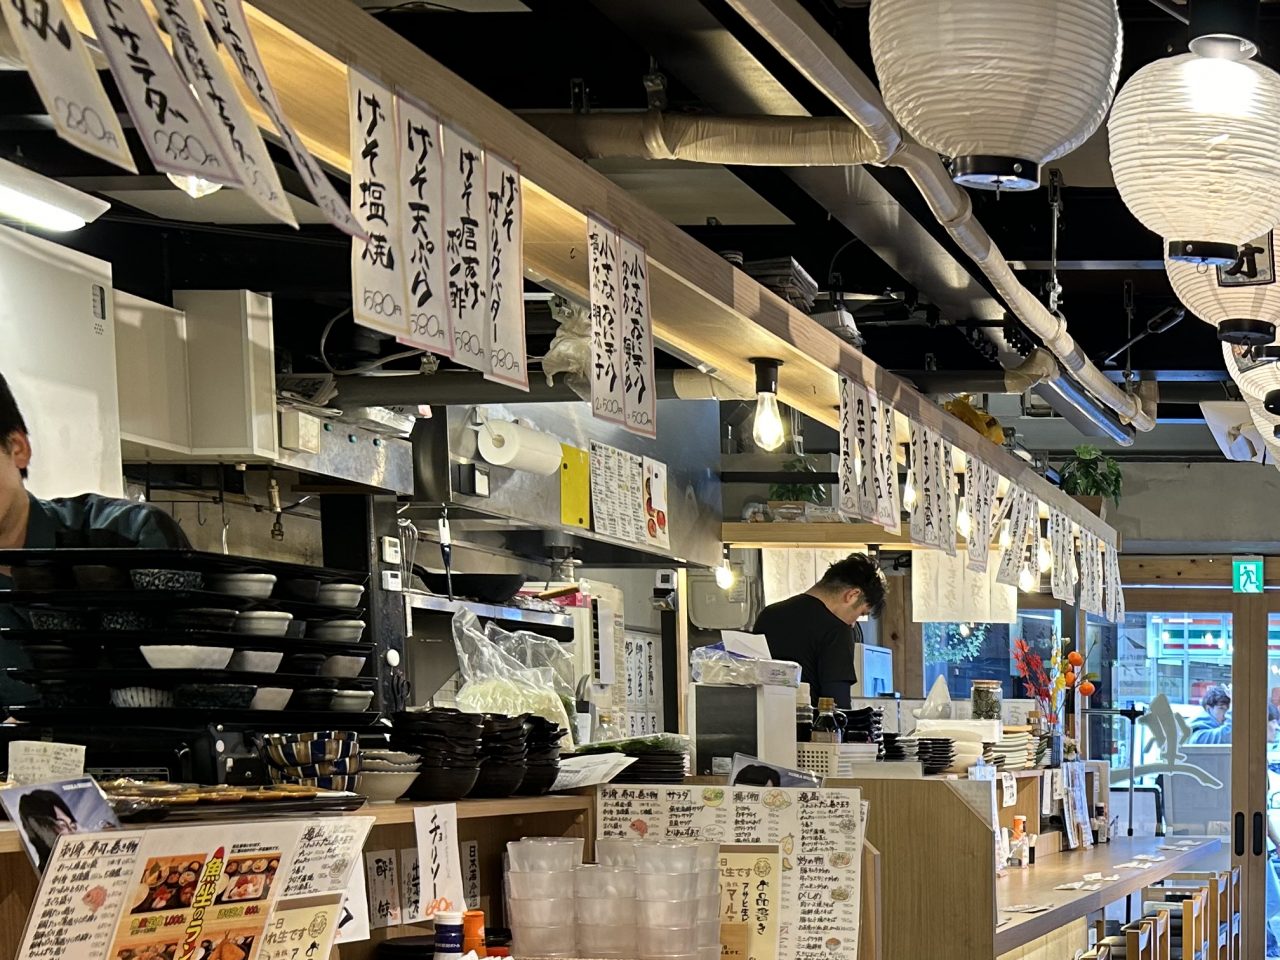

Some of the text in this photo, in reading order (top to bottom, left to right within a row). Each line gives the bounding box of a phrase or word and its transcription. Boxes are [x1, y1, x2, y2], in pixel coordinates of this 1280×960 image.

[358, 88, 395, 271] げそ塩焼
[407, 118, 435, 308] げそ天ぷら
[500, 170, 519, 243] げそ
[446, 228, 467, 320] ポン酢
[363, 286, 402, 318] 580円
[411, 312, 445, 338] 580円
[453, 326, 486, 358] 580円
[490, 348, 520, 374] 580円
[666, 790, 690, 800] サラダ
[429, 813, 442, 900] チョリソー
